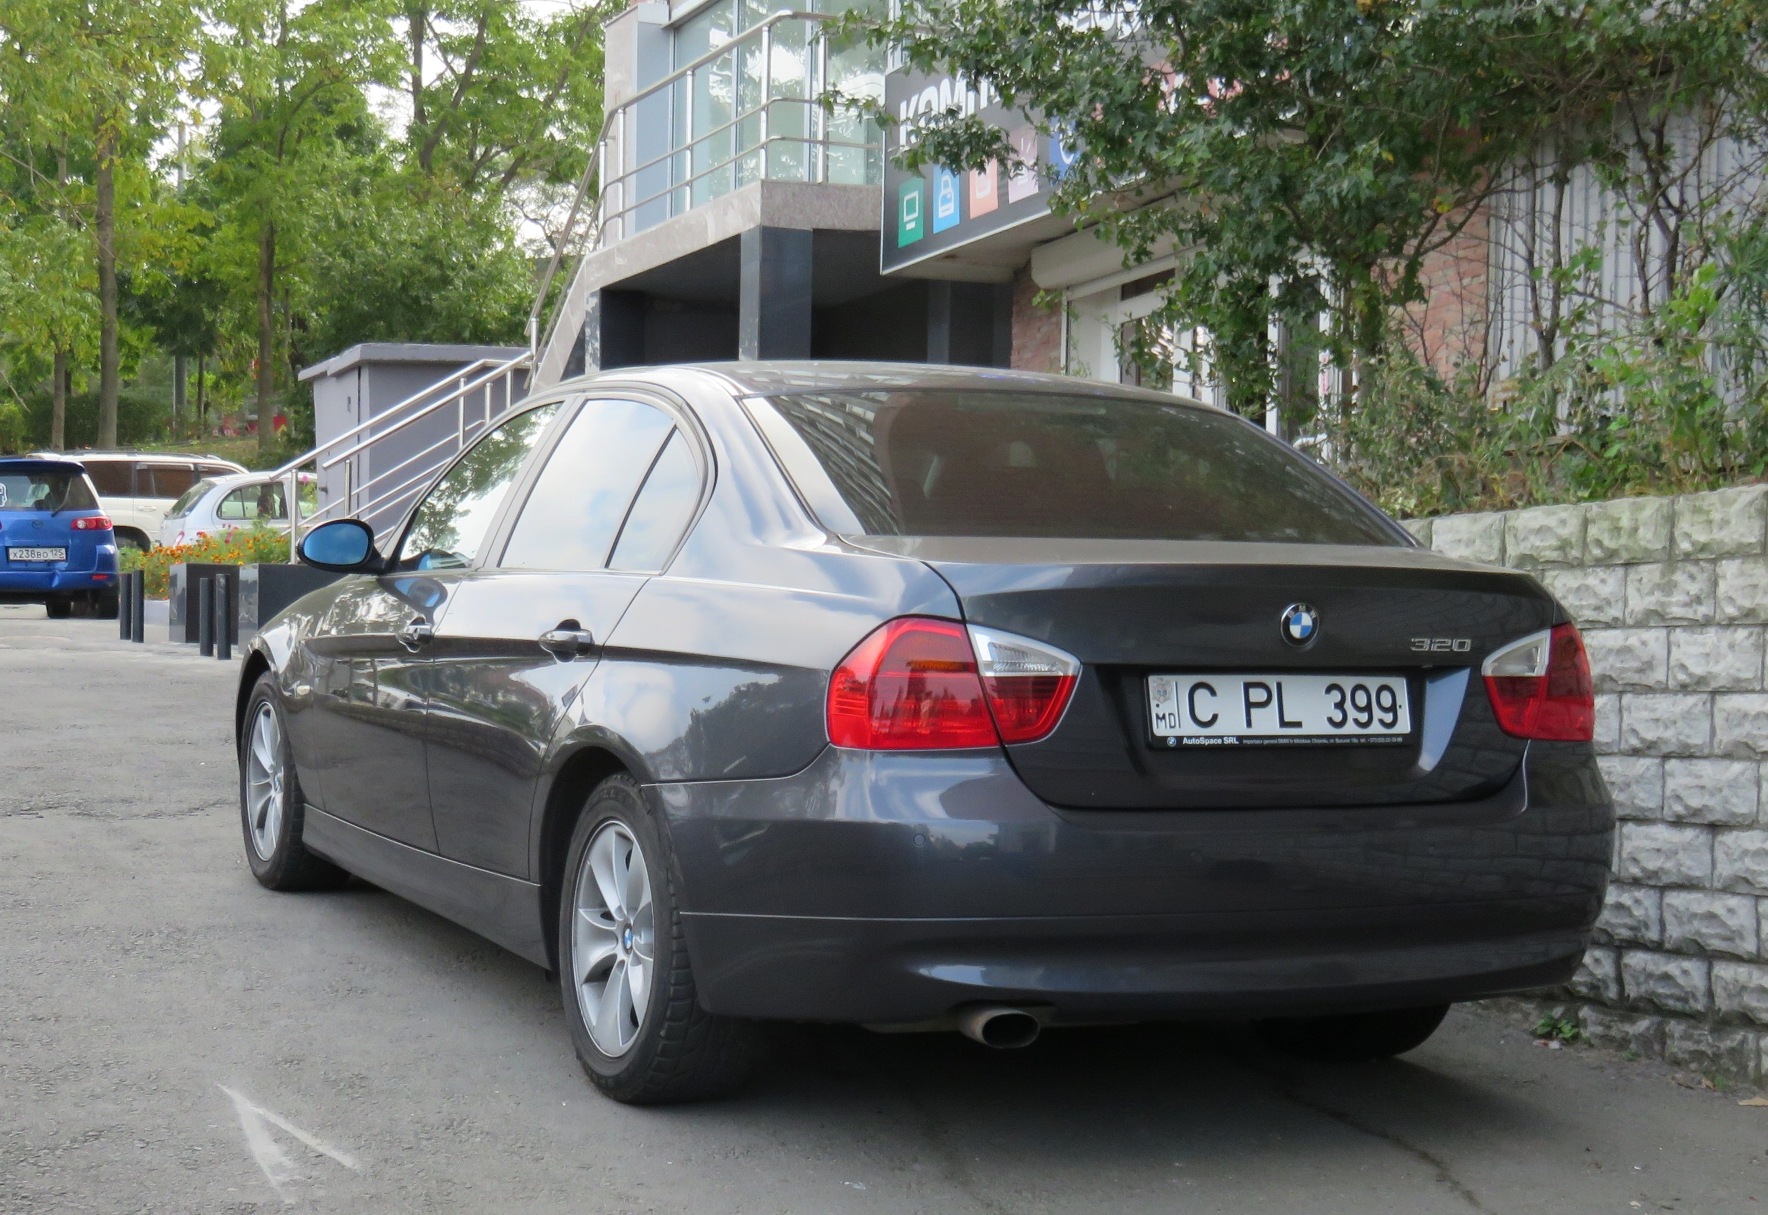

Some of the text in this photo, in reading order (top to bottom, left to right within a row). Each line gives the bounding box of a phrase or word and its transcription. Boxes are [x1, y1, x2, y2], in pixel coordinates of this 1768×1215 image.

[1410, 638, 1471, 652] 320
[1188, 681, 1398, 729] C PL 399
[1155, 713, 1176, 729] MD
[1182, 737, 1223, 746] AutoSpace
[1223, 736, 1240, 745] SRL
